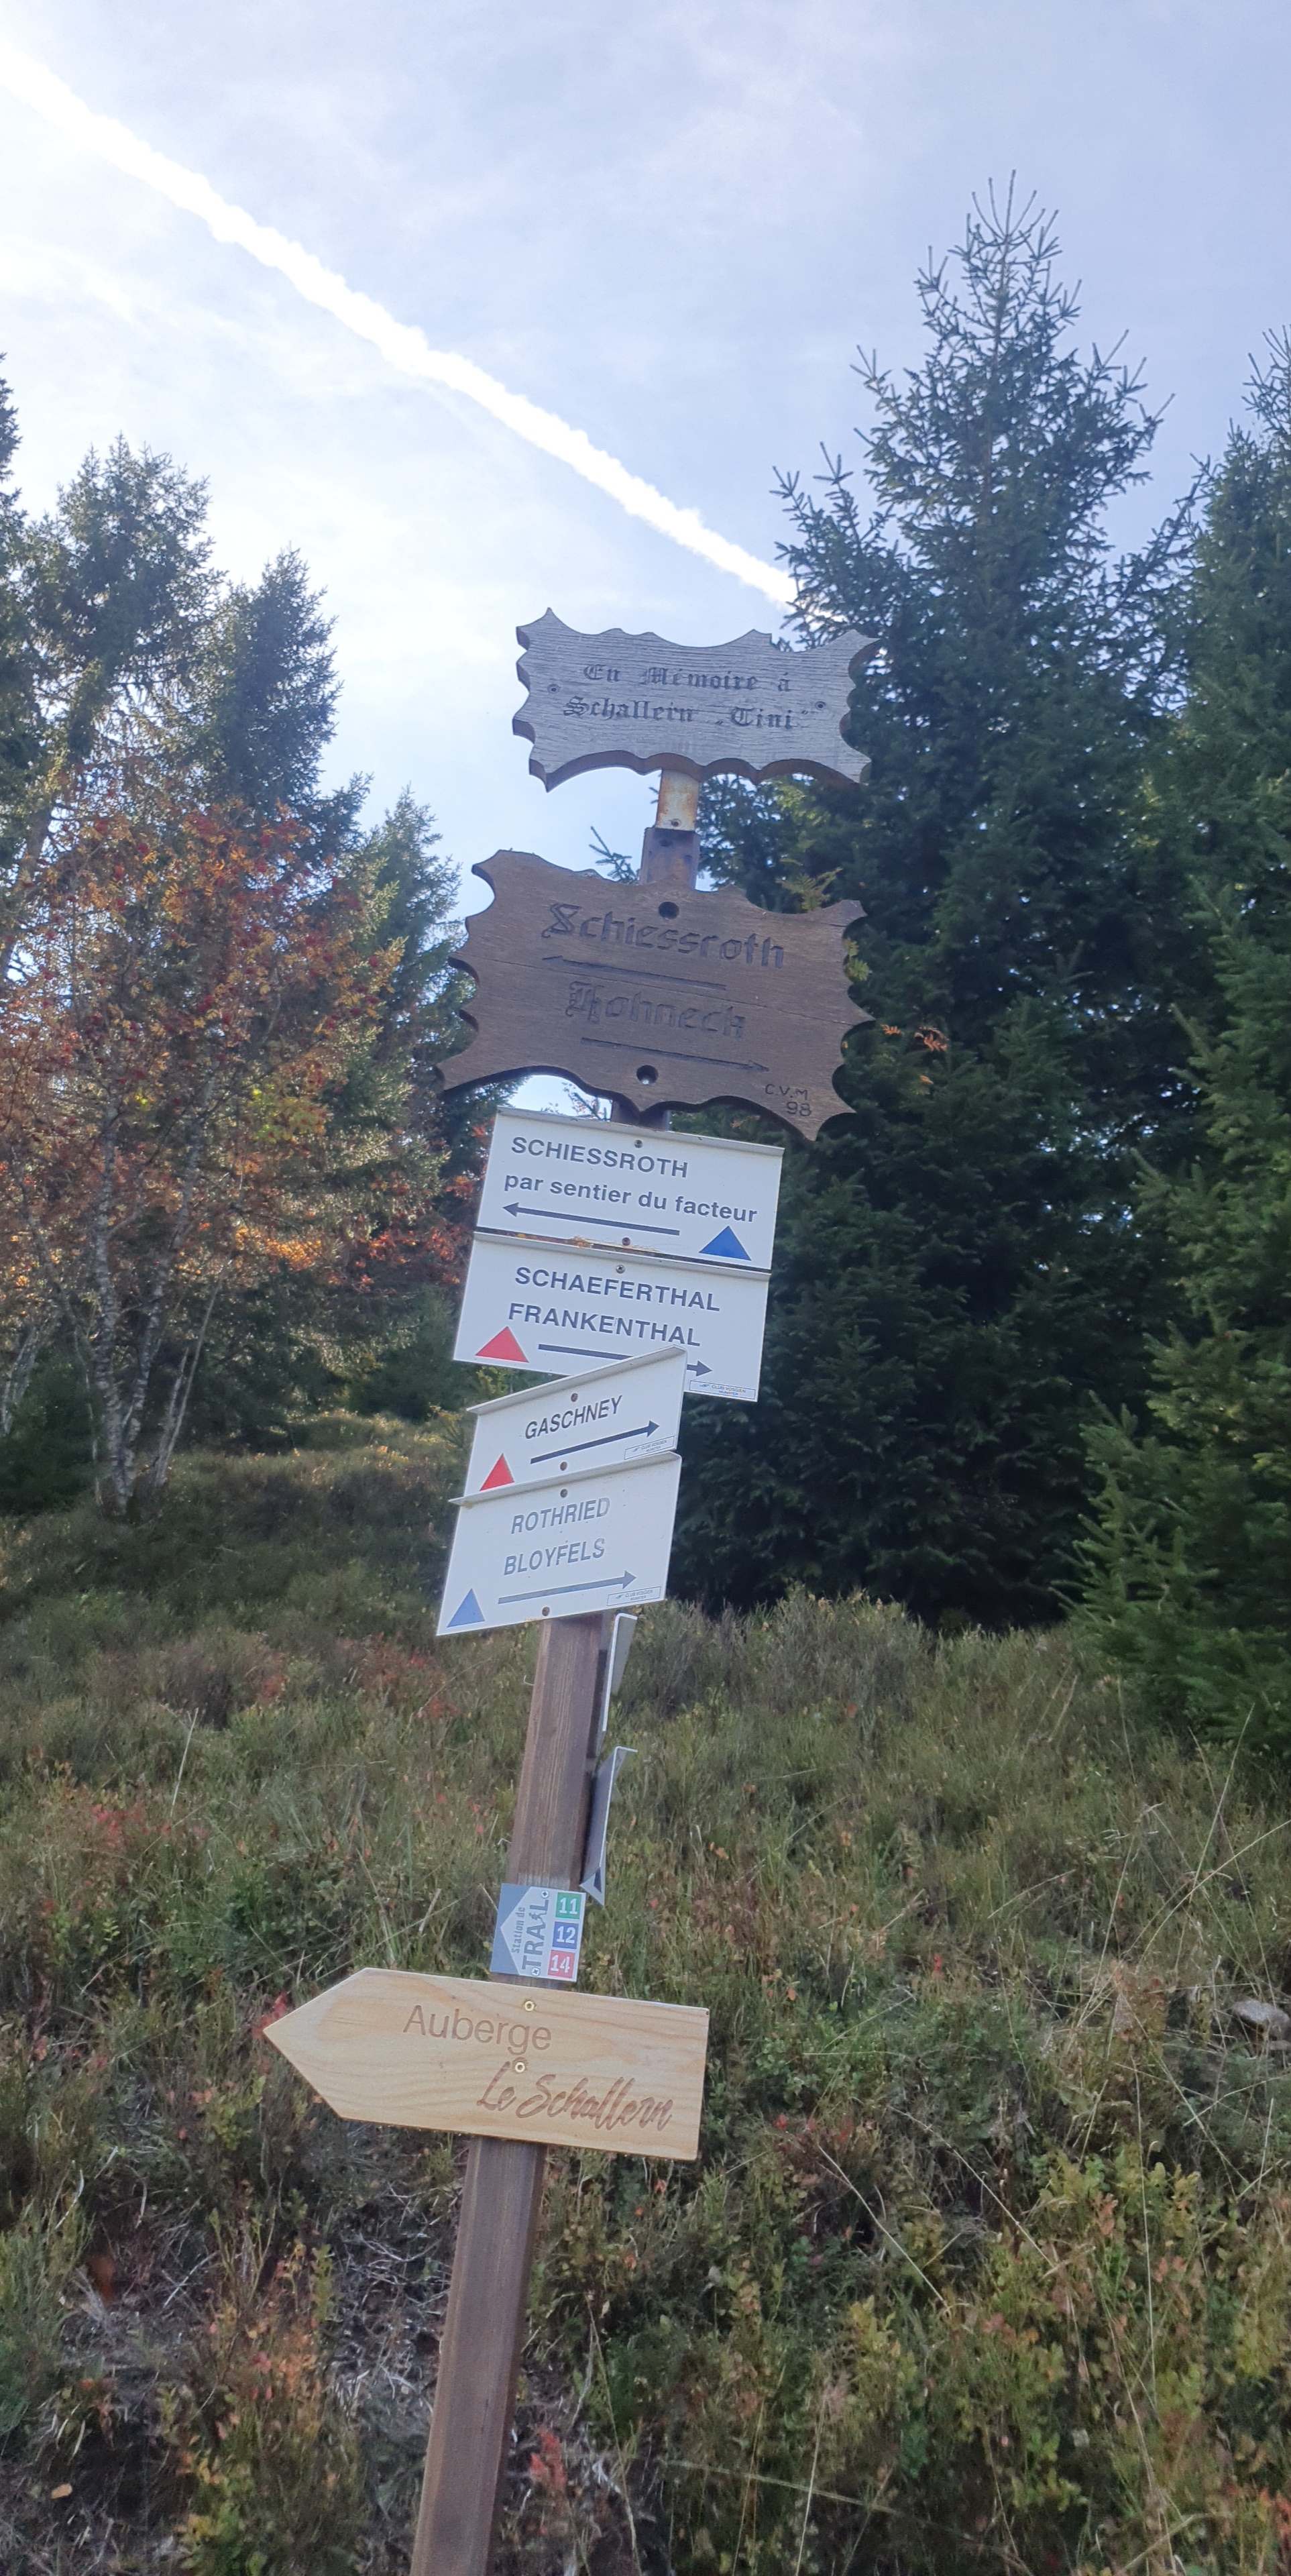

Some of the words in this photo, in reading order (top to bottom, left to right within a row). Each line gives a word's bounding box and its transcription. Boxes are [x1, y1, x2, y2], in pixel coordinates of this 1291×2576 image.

[583, 664, 620, 683] En
[638, 667, 758, 690] Mémoire
[541, 903, 785, 969] Schiessroth
[787, 1101, 812, 1117] 98
[511, 1136, 689, 1178] SCHIESSROTH
[504, 1173, 544, 1192] par
[550, 1181, 632, 1204] sentier
[638, 1191, 667, 1210] du
[675, 1196, 758, 1223] facteur
[514, 1267, 720, 1311] SCHAEFERTHAL
[508, 1303, 701, 1347] FRANKENTHAL
[525, 1395, 623, 1440] GASCHNEY
[511, 1497, 611, 1535] ROTHRIED
[504, 1538, 605, 1576] BLOYFELS
[515, 1907, 526, 1918] de
[559, 1897, 577, 1915] 11
[511, 1920, 525, 1953] Station
[556, 1926, 576, 1944] 12
[550, 1955, 570, 1974] 14
[403, 2004, 552, 2055] Auberge
[477, 2060, 516, 2112] Le
[516, 2074, 675, 2132] Schallern
